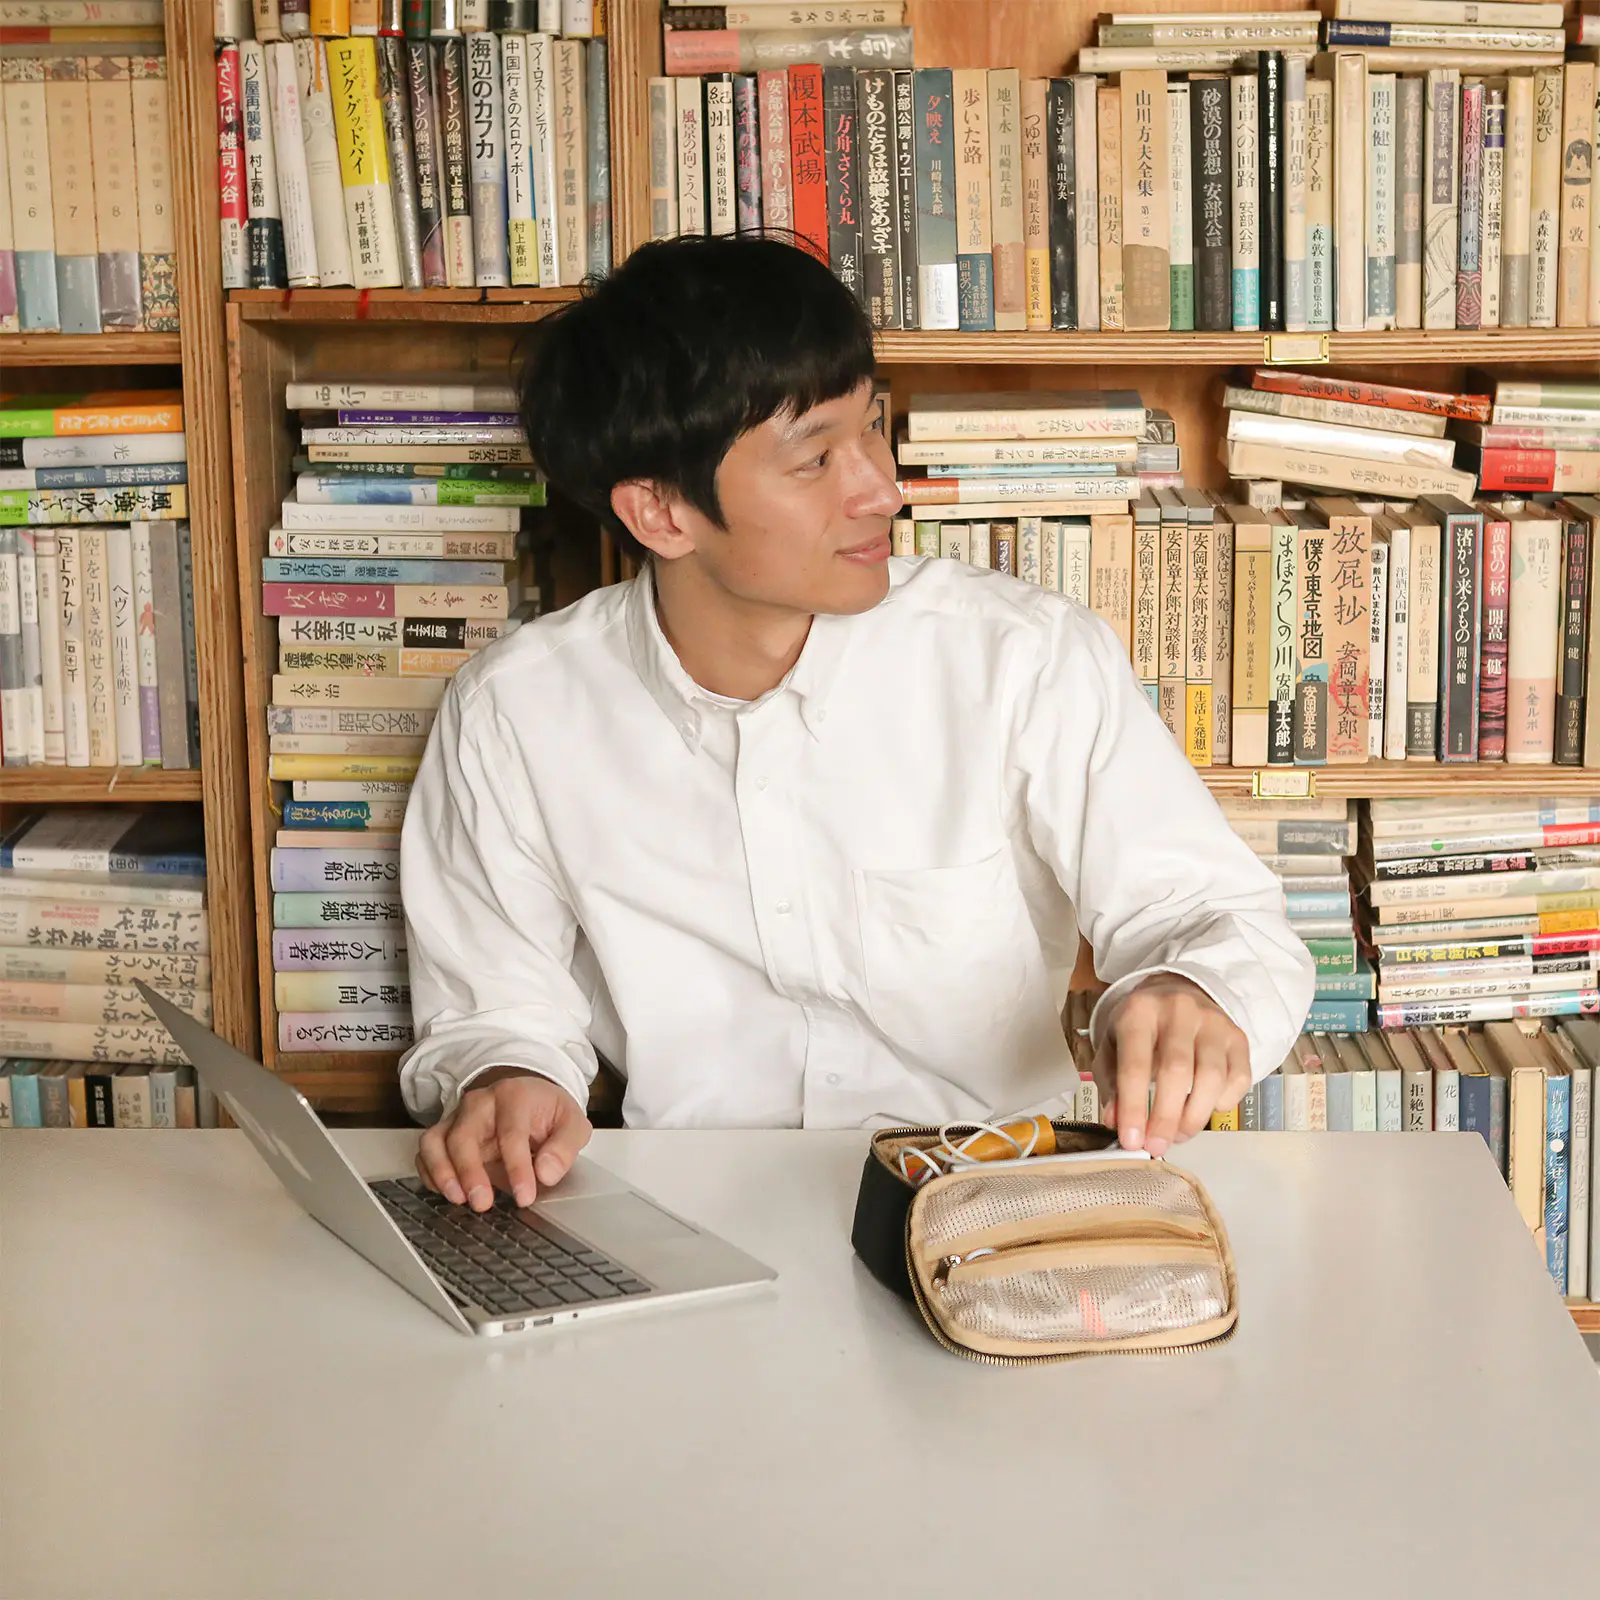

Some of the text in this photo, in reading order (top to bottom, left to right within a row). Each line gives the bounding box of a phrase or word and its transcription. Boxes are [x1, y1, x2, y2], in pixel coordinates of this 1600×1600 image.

[789, 9, 885, 24] 地下室の女神
[828, 34, 896, 61] 富士
[471, 38, 495, 159] 海辺のカフカ
[560, 45, 577, 206] レイモンド・カーヴァー傑作選
[708, 86, 732, 127] 紀州
[767, 79, 783, 143] 安部公房
[963, 89, 984, 165] 歩いた路
[1372, 90, 1390, 147] 開高健
[218, 57, 239, 204] さらば雑司ヶ谷
[244, 53, 264, 207] パン屋再襲撃 村上春樹
[340, 49, 371, 265] ロング・グッドバイ 村上春樹訳
[411, 48, 433, 209] レキシントンの幽霊 村上春樹
[505, 39, 527, 267] 中国行きのスロウ・ボート 村上春樹
[530, 40, 546, 152] マイ・ロスト・シティー
[541, 218, 553, 265] 村上春樹
[683, 108, 698, 200] 風景の向こうへ
[793, 74, 822, 185] 榎本武揚
[897, 83, 912, 191] 安部公房 ウエー
[926, 95, 943, 216] 夕映え 川崎長太郎
[996, 87, 1013, 207] 地下水 川崎長太郎
[1056, 96, 1068, 200] トコという男 山川方夫
[1136, 89, 1154, 198] 山川方夫全集
[1201, 88, 1222, 175] 砂漠の思想
[1236, 84, 1255, 188] 都市への回路
[1289, 107, 1305, 188] 江戸川乱歩
[449, 167, 464, 209] 村上春樹
[481, 171, 489, 181] 上
[716, 133, 728, 217] 木の国・根の国物語
[835, 114, 855, 226] 方舟さくら丸
[865, 78, 893, 254] けものたちは故郷をめざす
[1024, 114, 1042, 236] つゆ草 川崎長太郎
[28, 207, 37, 218] 6
[70, 207, 77, 218] 7
[113, 206, 121, 217] 8
[155, 205, 163, 216] 9
[478, 187, 496, 258] 村上春樹
[968, 181, 982, 246] 川崎長太郎
[1082, 188, 1097, 246] 山川方夫
[1103, 195, 1119, 246] 山川方夫
[1238, 202, 1254, 255] 安部公房
[1569, 194, 1585, 242] 森敦
[959, 260, 972, 319] 回想の六十年
[1311, 228, 1325, 318] 森敦 最後の自伝小説
[1536, 256, 1545, 314] 最後の自伝小説
[315, 386, 366, 407] 西行
[43, 467, 180, 485] 木暮荘物語 三浦しをん
[113, 441, 130, 460] 光
[468, 448, 521, 462] 坂口安吾
[994, 447, 1126, 460] 世界短篇名作選 ロシア編
[28, 492, 172, 513] 風が強く吹いている
[1350, 469, 1459, 492] 目まいのする散歩
[298, 539, 370, 552] 安吾探偵控
[899, 531, 911, 543] 花
[279, 562, 399, 578] 切支丹の里 遠藤周作
[284, 588, 498, 610] 皮膚と心 太宰治
[1069, 549, 1082, 596] 文士の友
[1395, 567, 1407, 610] 洋酒天国
[1418, 544, 1432, 606] 自叙伝旅行
[1568, 534, 1585, 660] 開口閉口 開高 健
[58, 535, 78, 682] 屋上がえり 石田千
[84, 536, 106, 714] 空を引き寄せる石
[291, 620, 397, 641] 太宰治と私
[1138, 532, 1155, 678] 安岡章太郎対談集 1
[1165, 530, 1183, 675] 安岡章太郎対談集 2
[1191, 532, 1209, 677] 安岡章太郎対談集 3
[1371, 566, 1382, 643] 齢八十いまなお勉強
[1455, 527, 1473, 685] 渚から来るもの 開高健
[1487, 527, 1506, 675] 黄昏の一杯 開高 健
[112, 584, 131, 706] ヘヴン 川上未映子
[1275, 534, 1295, 748] まぼろしの川 安岡章太郎
[1300, 538, 1324, 749] 僕の東京地図 安岡章太郎
[1331, 526, 1368, 740] 放屁抄 安岡章太郎
[290, 683, 339, 698] 太宰治
[1193, 690, 1207, 750] 生活と発想
[1216, 693, 1227, 744] 安岡章太郎
[1525, 693, 1540, 730] 全ルポ
[339, 713, 420, 733] 昭和の文学
[324, 860, 399, 881] の快走船
[27, 926, 199, 952] となりに脱走兵が
[115, 907, 201, 933] いた時代
[320, 901, 403, 921] 界神秘郷
[106, 956, 198, 976] 何だろうか
[93, 1045, 186, 1065] 近代とは
[1444, 1085, 1457, 1127] 花束
[1574, 1081, 1589, 1139] 麻雀好日
